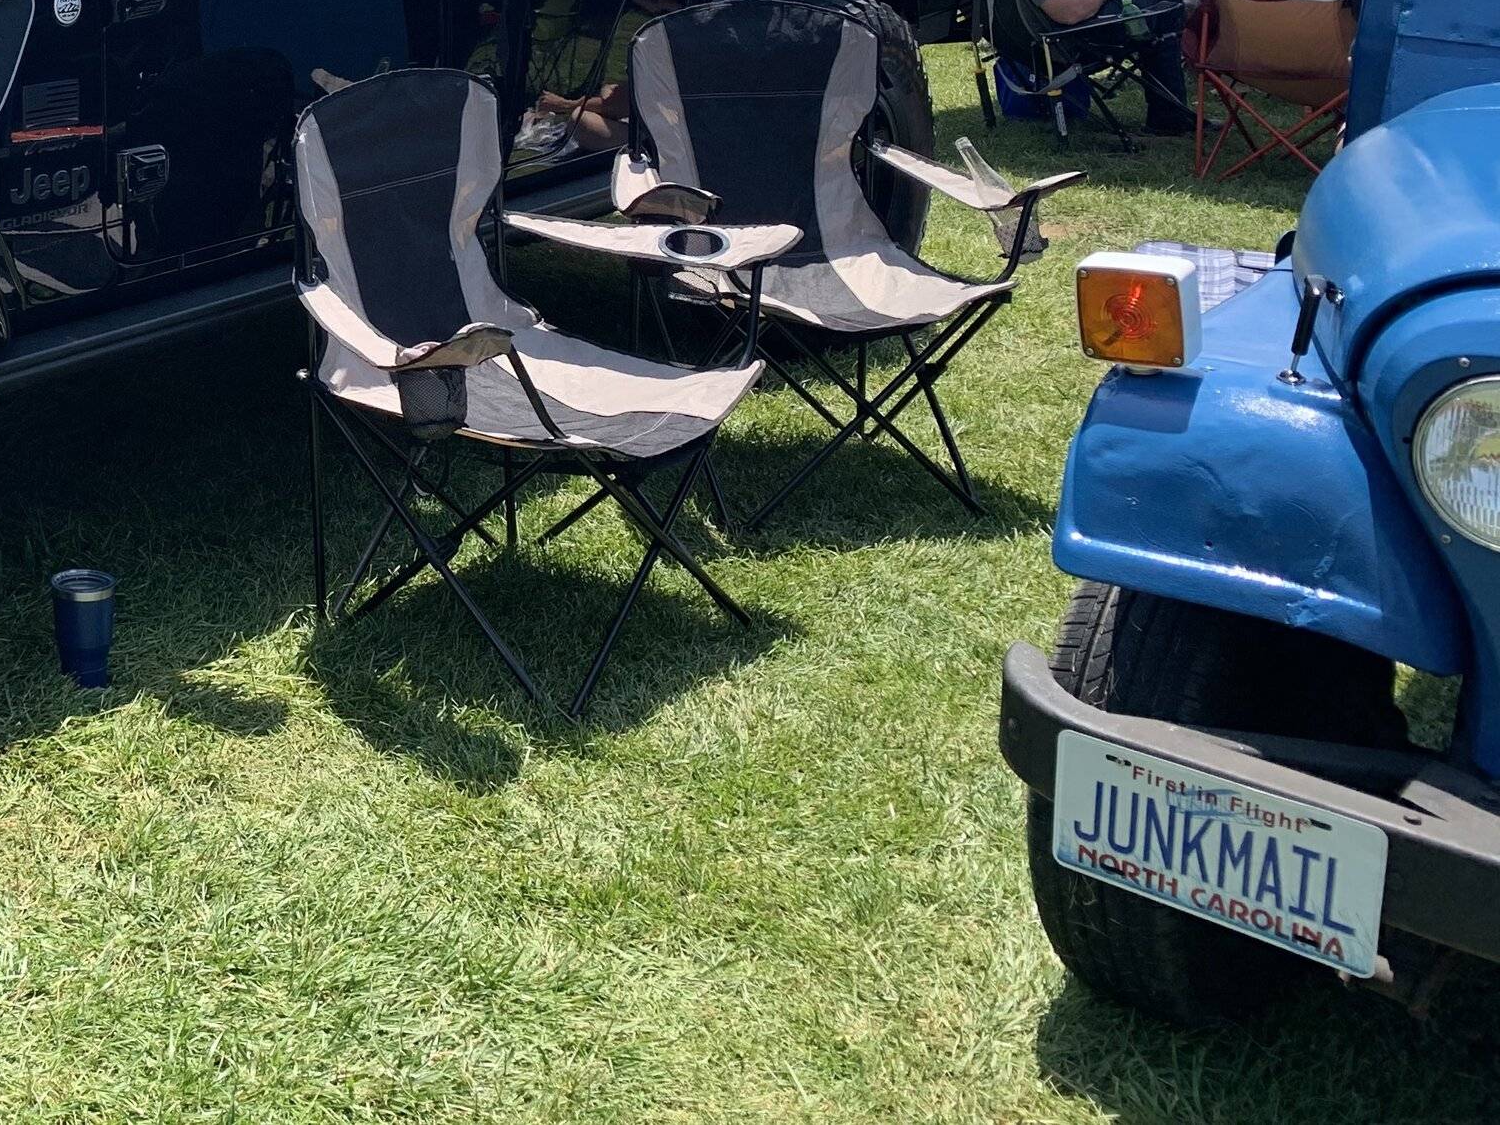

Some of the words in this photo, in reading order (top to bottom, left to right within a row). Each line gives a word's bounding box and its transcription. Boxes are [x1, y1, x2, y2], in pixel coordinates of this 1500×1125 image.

[0, 203, 90, 230] GLADIATOR
[10, 165, 90, 205] Jeep
[1132, 765, 1187, 795] First
[1197, 786, 1218, 806] in
[1229, 796, 1304, 834] Flight
[1074, 780, 1355, 936] JUNKMAIL
[1078, 844, 1179, 898] NORTH
[1191, 888, 1346, 962] CAROLINA
